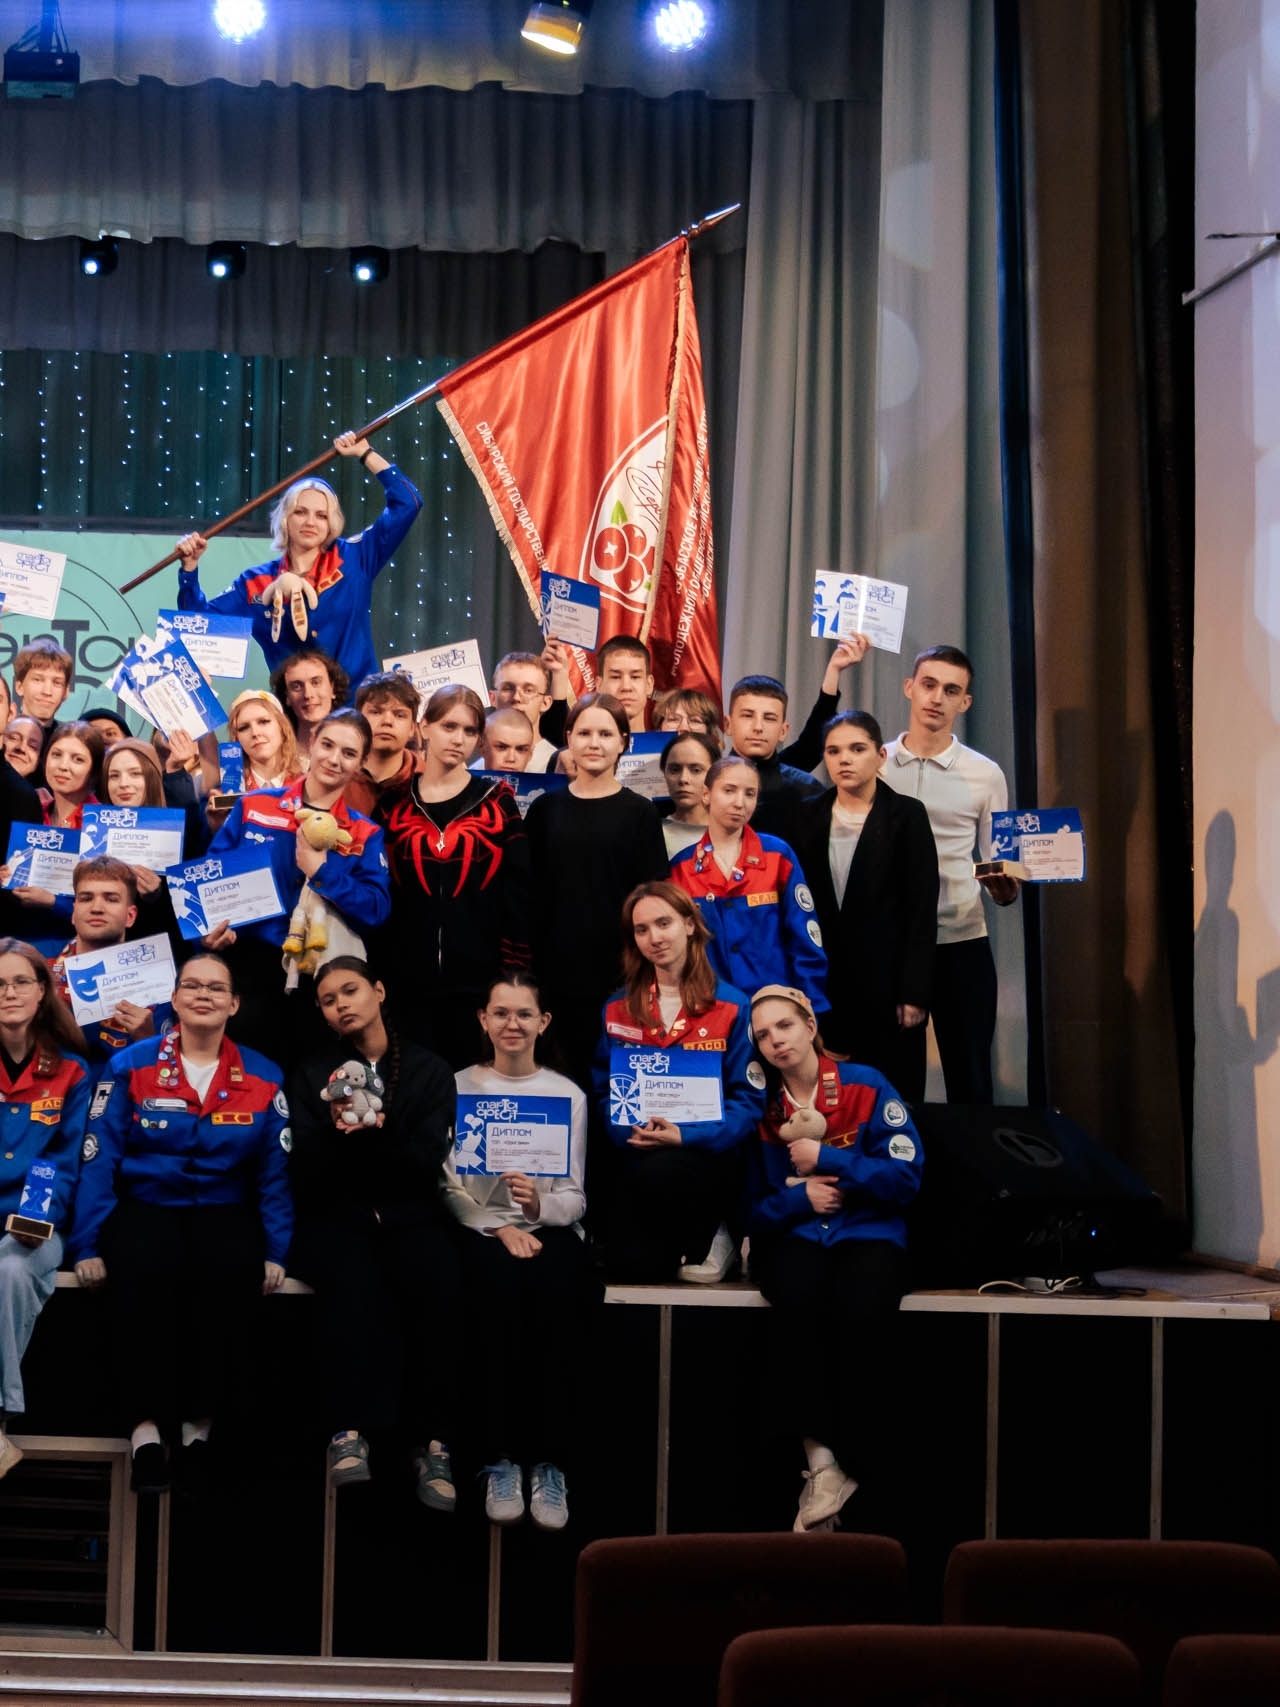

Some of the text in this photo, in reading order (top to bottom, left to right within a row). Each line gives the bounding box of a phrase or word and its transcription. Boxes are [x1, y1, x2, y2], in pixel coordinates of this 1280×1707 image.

[476, 420, 515, 490] СИБИРСКИЙ
[204, 881, 241, 898] Диплом
[101, 971, 139, 986] Диплом
[644, 1079, 684, 1090] Диплом
[491, 1126, 532, 1137] Диплом
